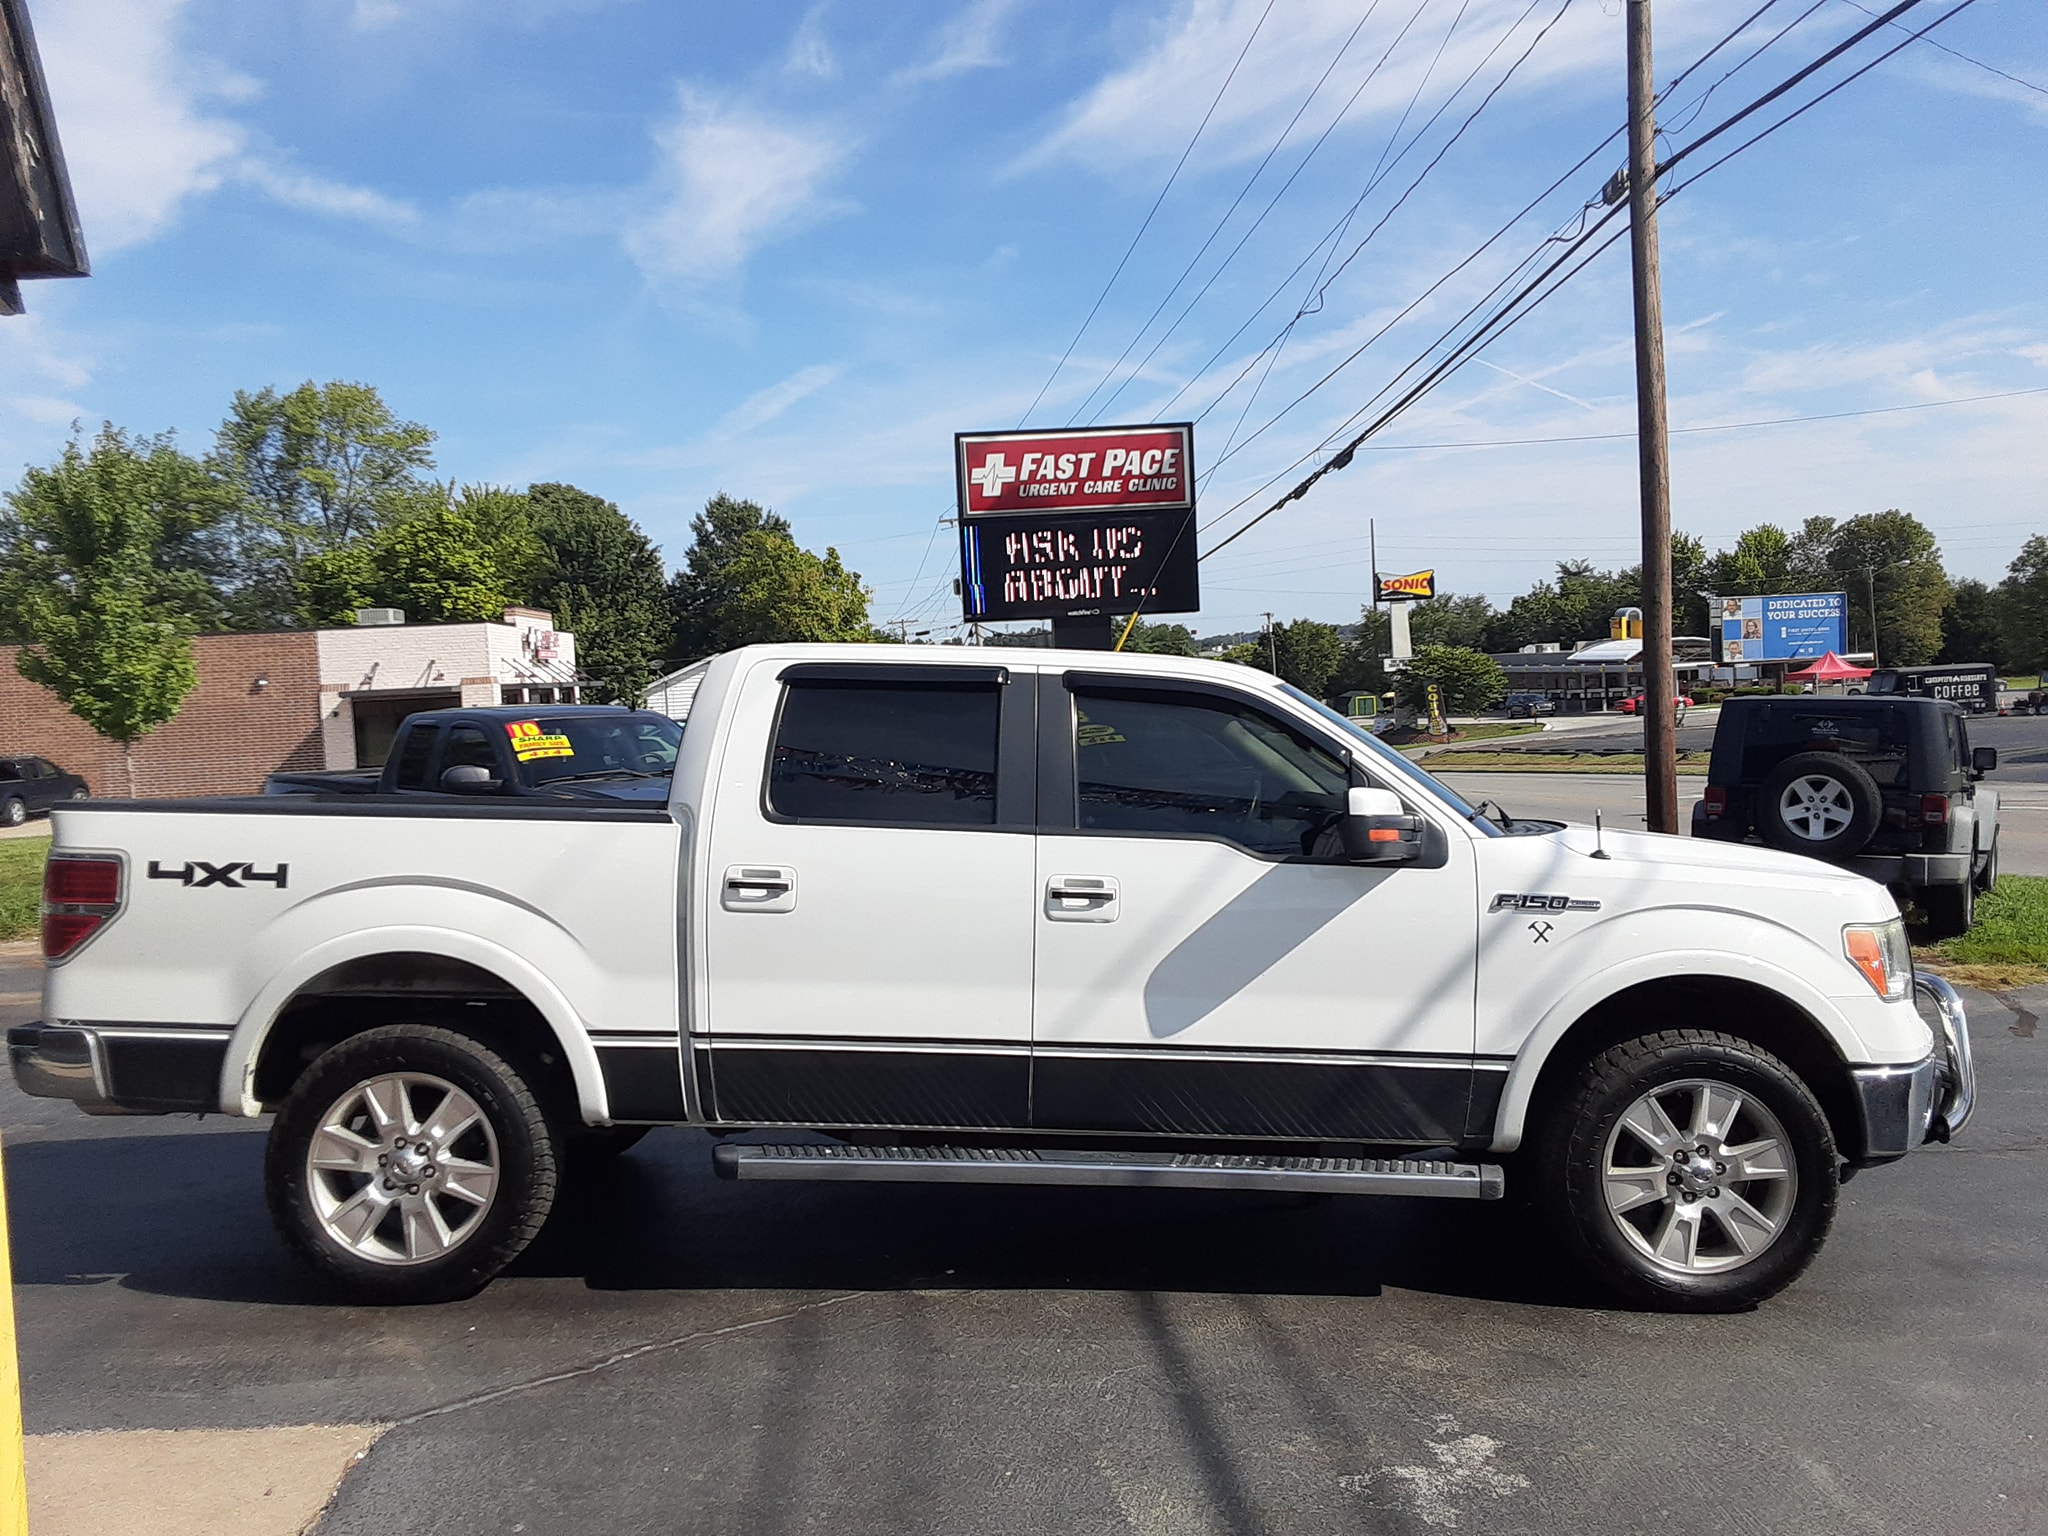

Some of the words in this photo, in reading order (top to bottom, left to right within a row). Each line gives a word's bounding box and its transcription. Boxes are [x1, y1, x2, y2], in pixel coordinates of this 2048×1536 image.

[1019, 453, 1097, 481] FAST
[1102, 448, 1181, 477] PACE
[1018, 481, 1078, 498] URGENT
[1083, 479, 1123, 494] CARE
[1128, 477, 1177, 492] CLINIC
[1005, 530, 1081, 564] ASK
[1092, 526, 1143, 560] US
[1382, 577, 1428, 591] SONIC
[1768, 599, 1826, 610] DEDICATED
[1828, 597, 1842, 607] TO
[1767, 610, 1796, 621] YOUR
[510, 722, 540, 738] 10
